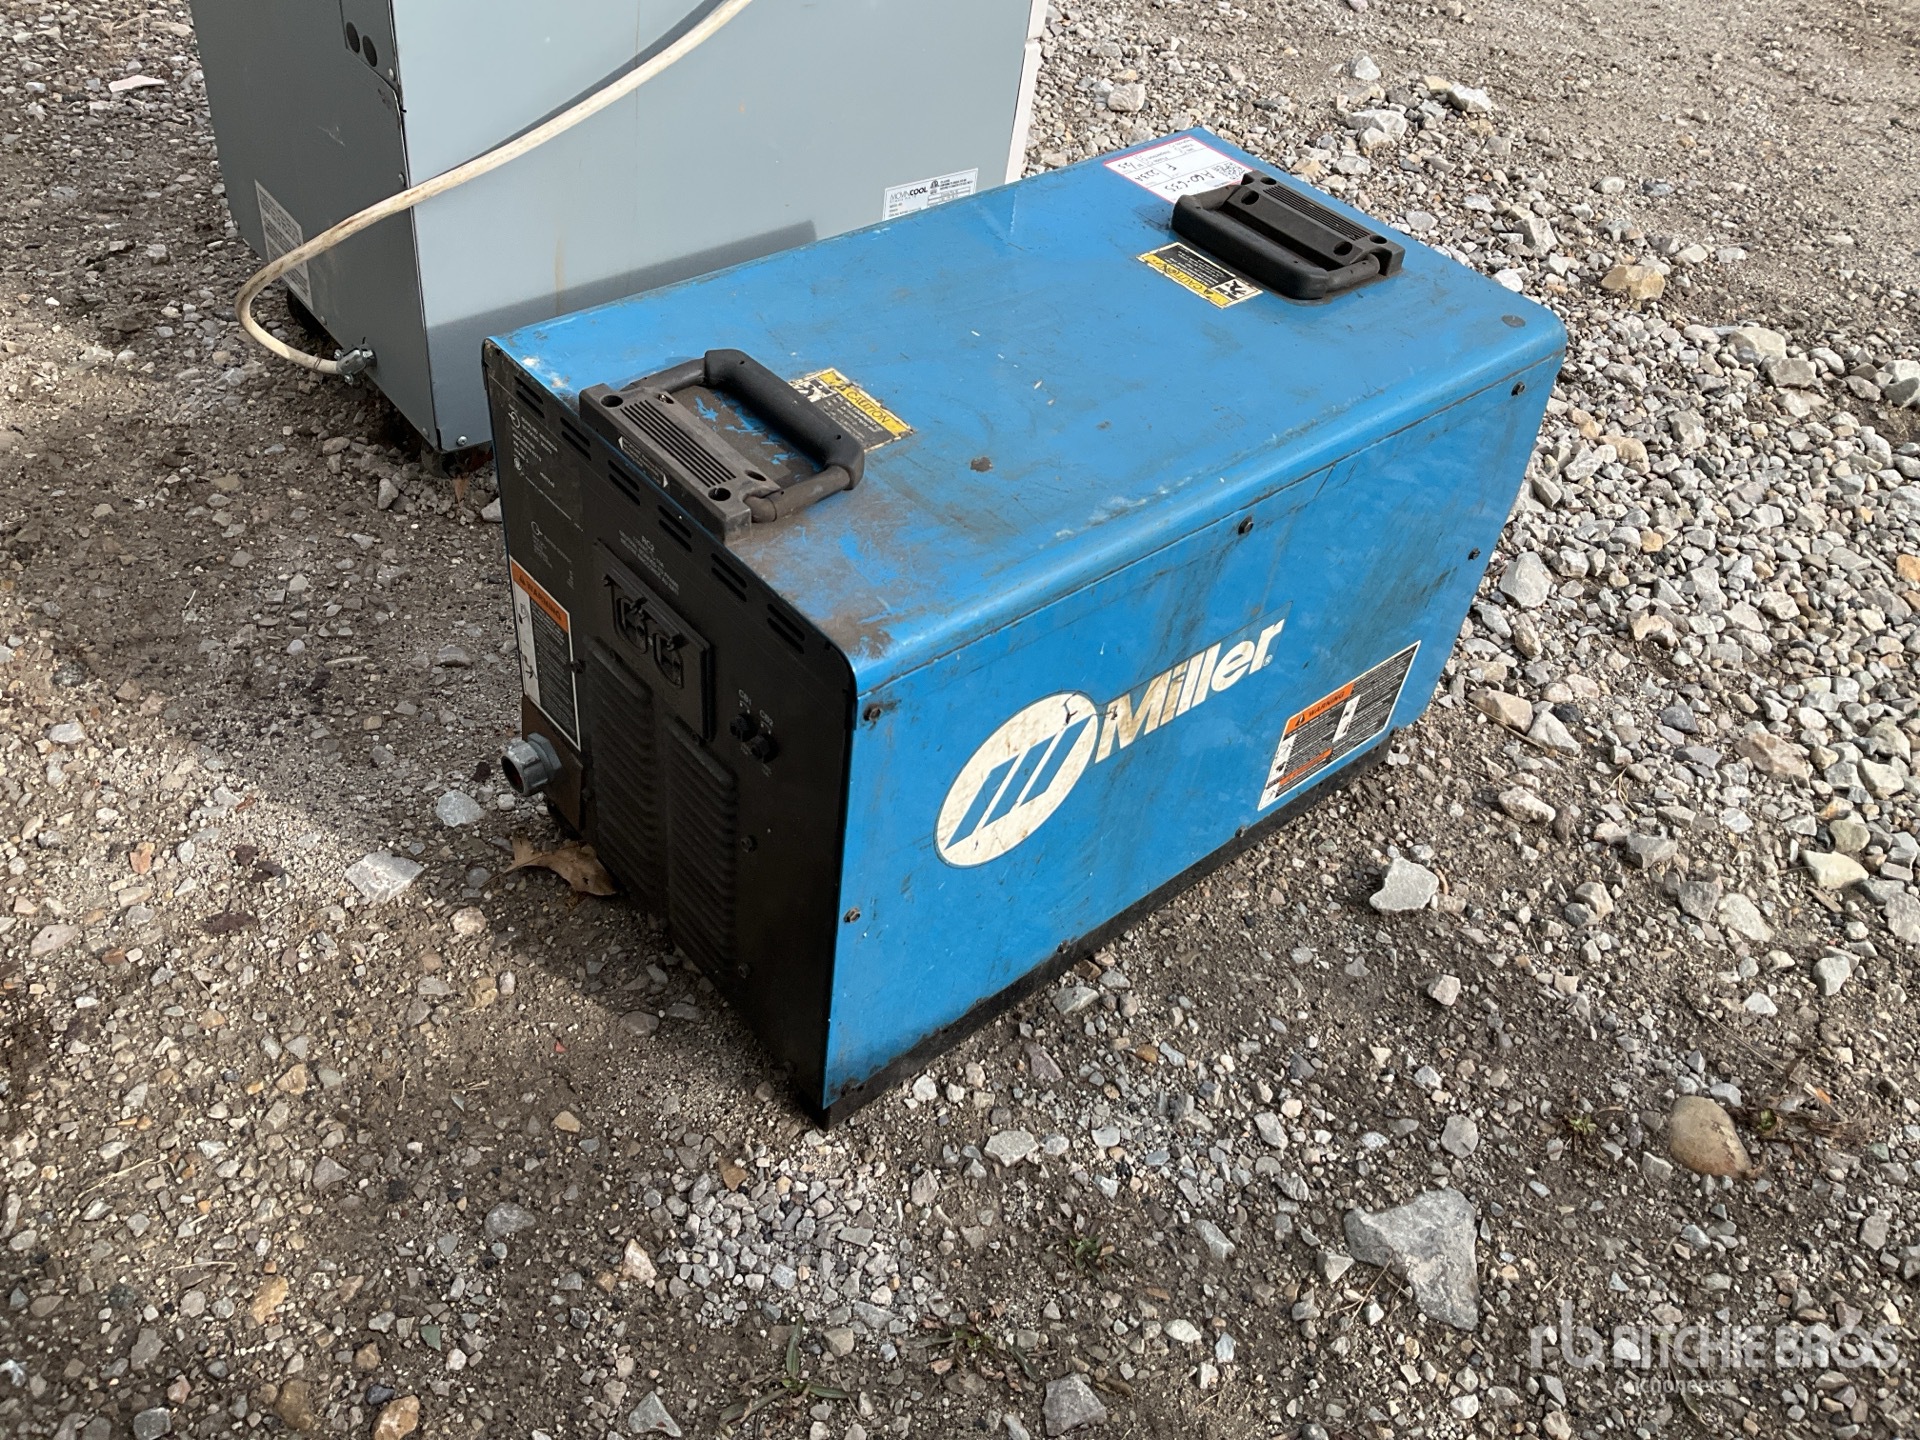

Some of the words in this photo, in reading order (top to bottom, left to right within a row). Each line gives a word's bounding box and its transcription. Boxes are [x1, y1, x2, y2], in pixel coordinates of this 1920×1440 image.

[846, 391, 891, 424] CAUTION
[527, 582, 562, 621] WARNING
[1095, 619, 1285, 763] Miller
[1308, 690, 1345, 717] WARNING
